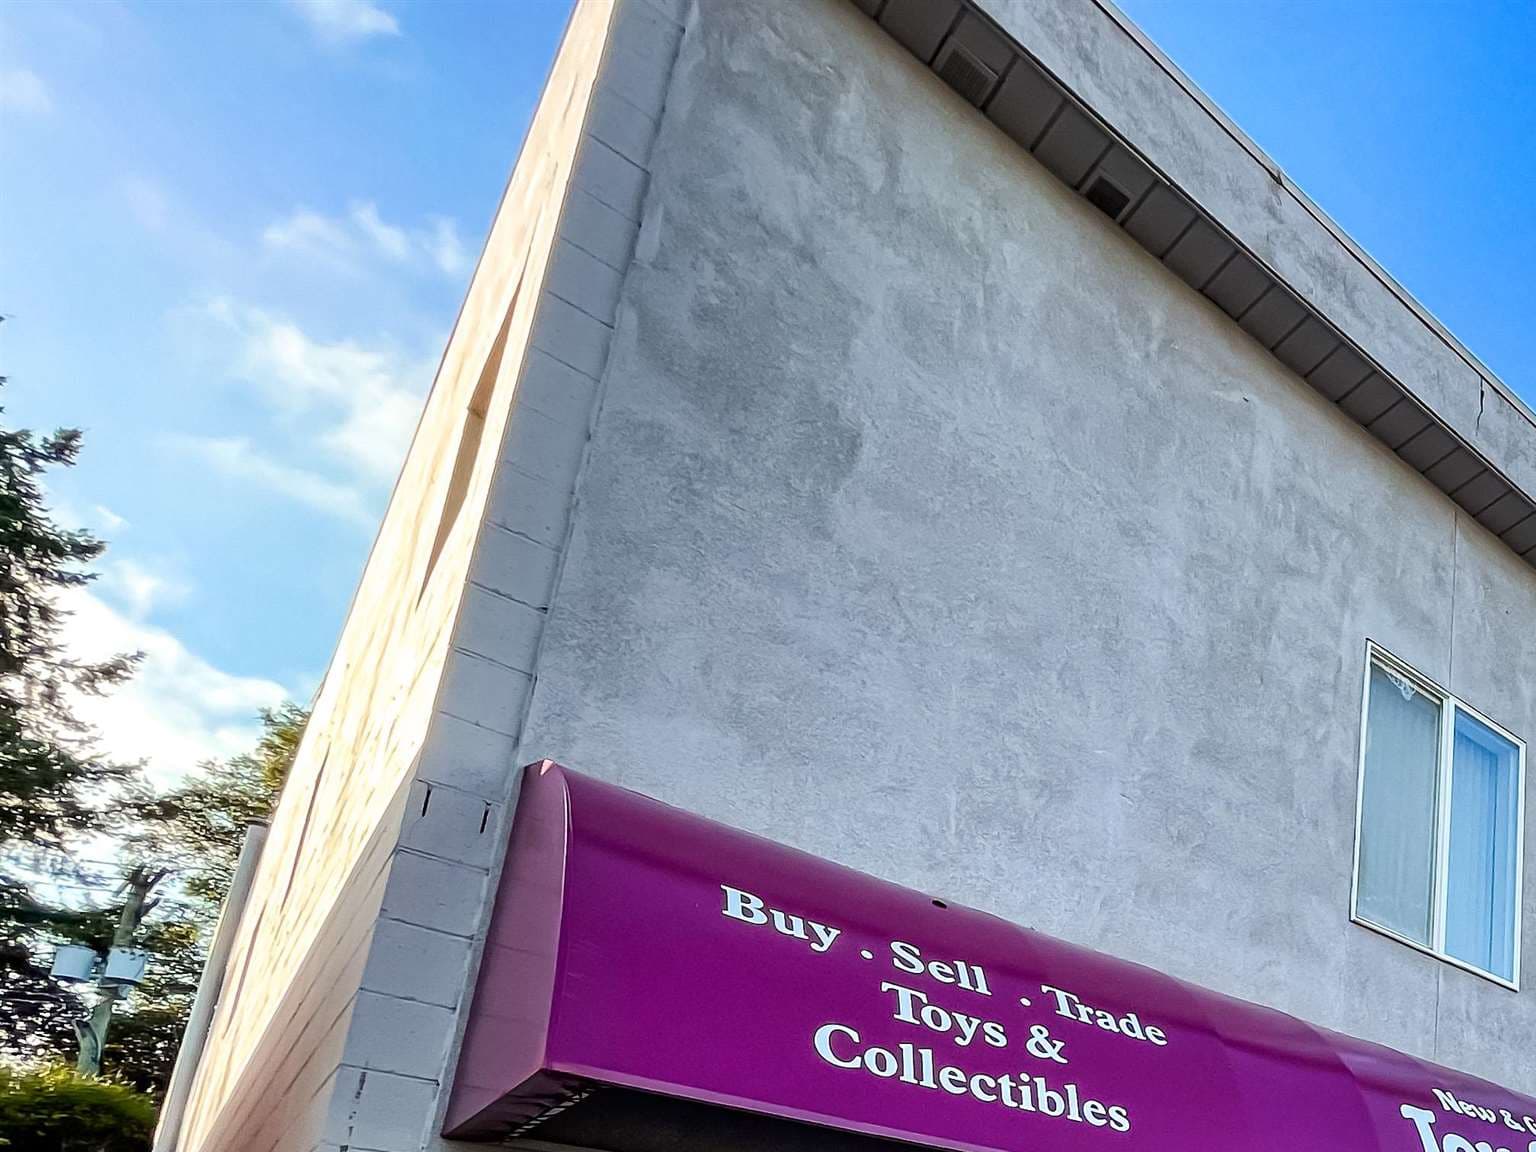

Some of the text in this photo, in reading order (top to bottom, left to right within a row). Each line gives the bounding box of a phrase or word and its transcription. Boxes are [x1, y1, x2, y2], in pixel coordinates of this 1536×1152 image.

[720, 884, 1169, 1046] Buy Sell Trade
[881, 981, 1069, 1064] Toys &
[813, 1022, 1131, 1132] Collectibles
[1432, 1088, 1497, 1124] New
[1499, 1109, 1526, 1132] &
